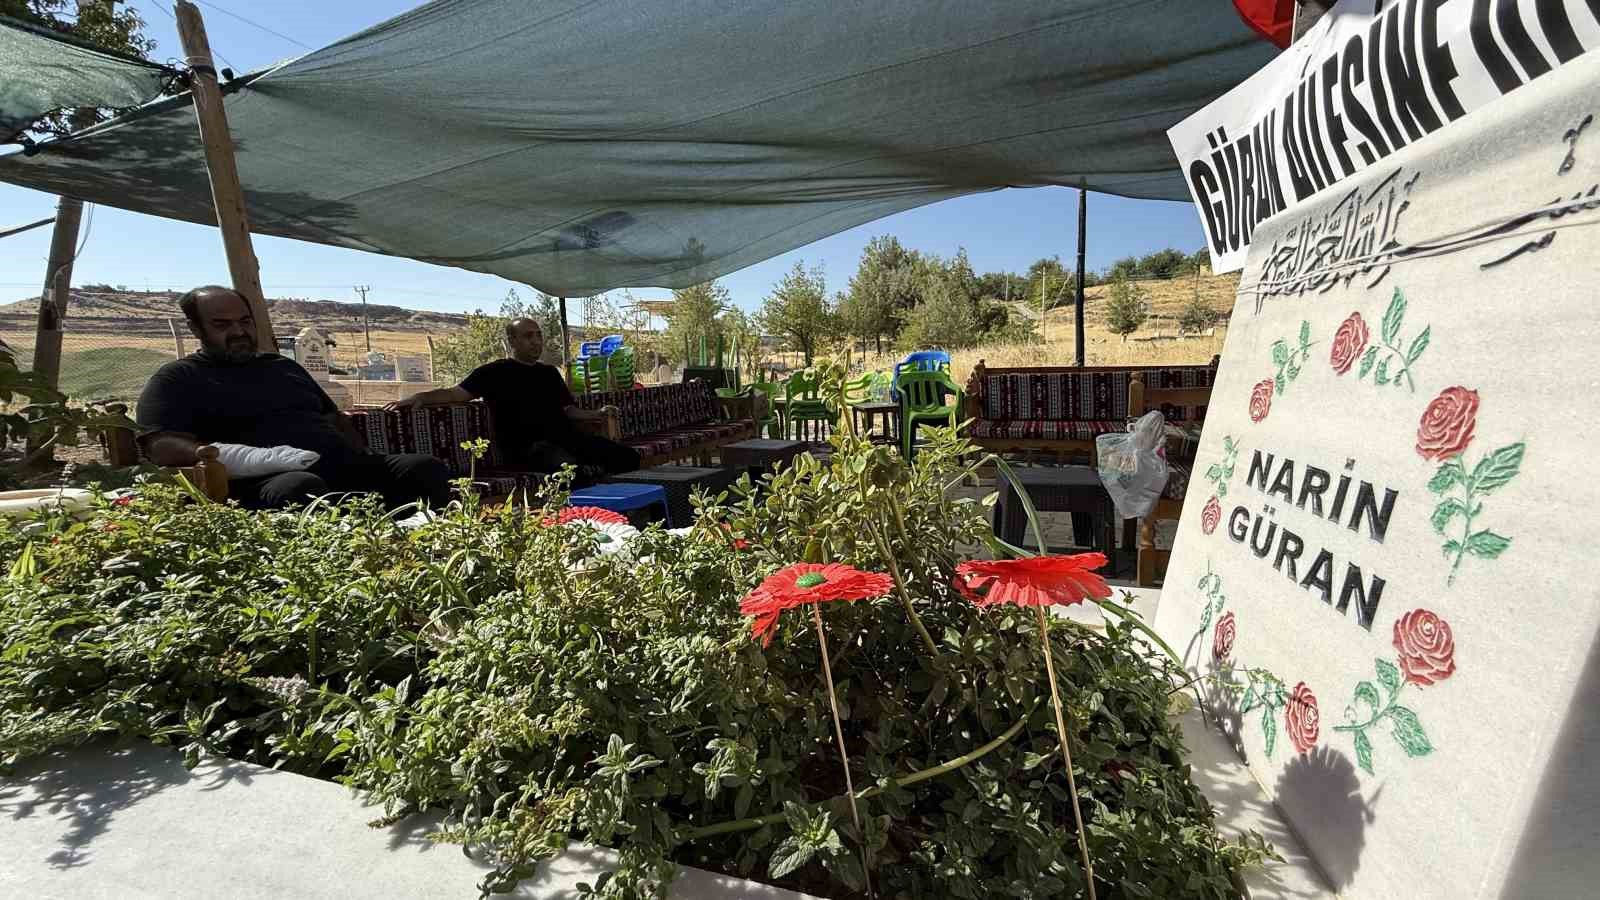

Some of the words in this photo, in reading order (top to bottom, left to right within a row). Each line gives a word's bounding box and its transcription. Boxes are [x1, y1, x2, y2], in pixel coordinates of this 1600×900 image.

[1190, 108, 1288, 257] GÜRAN
[1246, 449, 1399, 544] NARİN
[1228, 504, 1386, 633] GÜRAN
